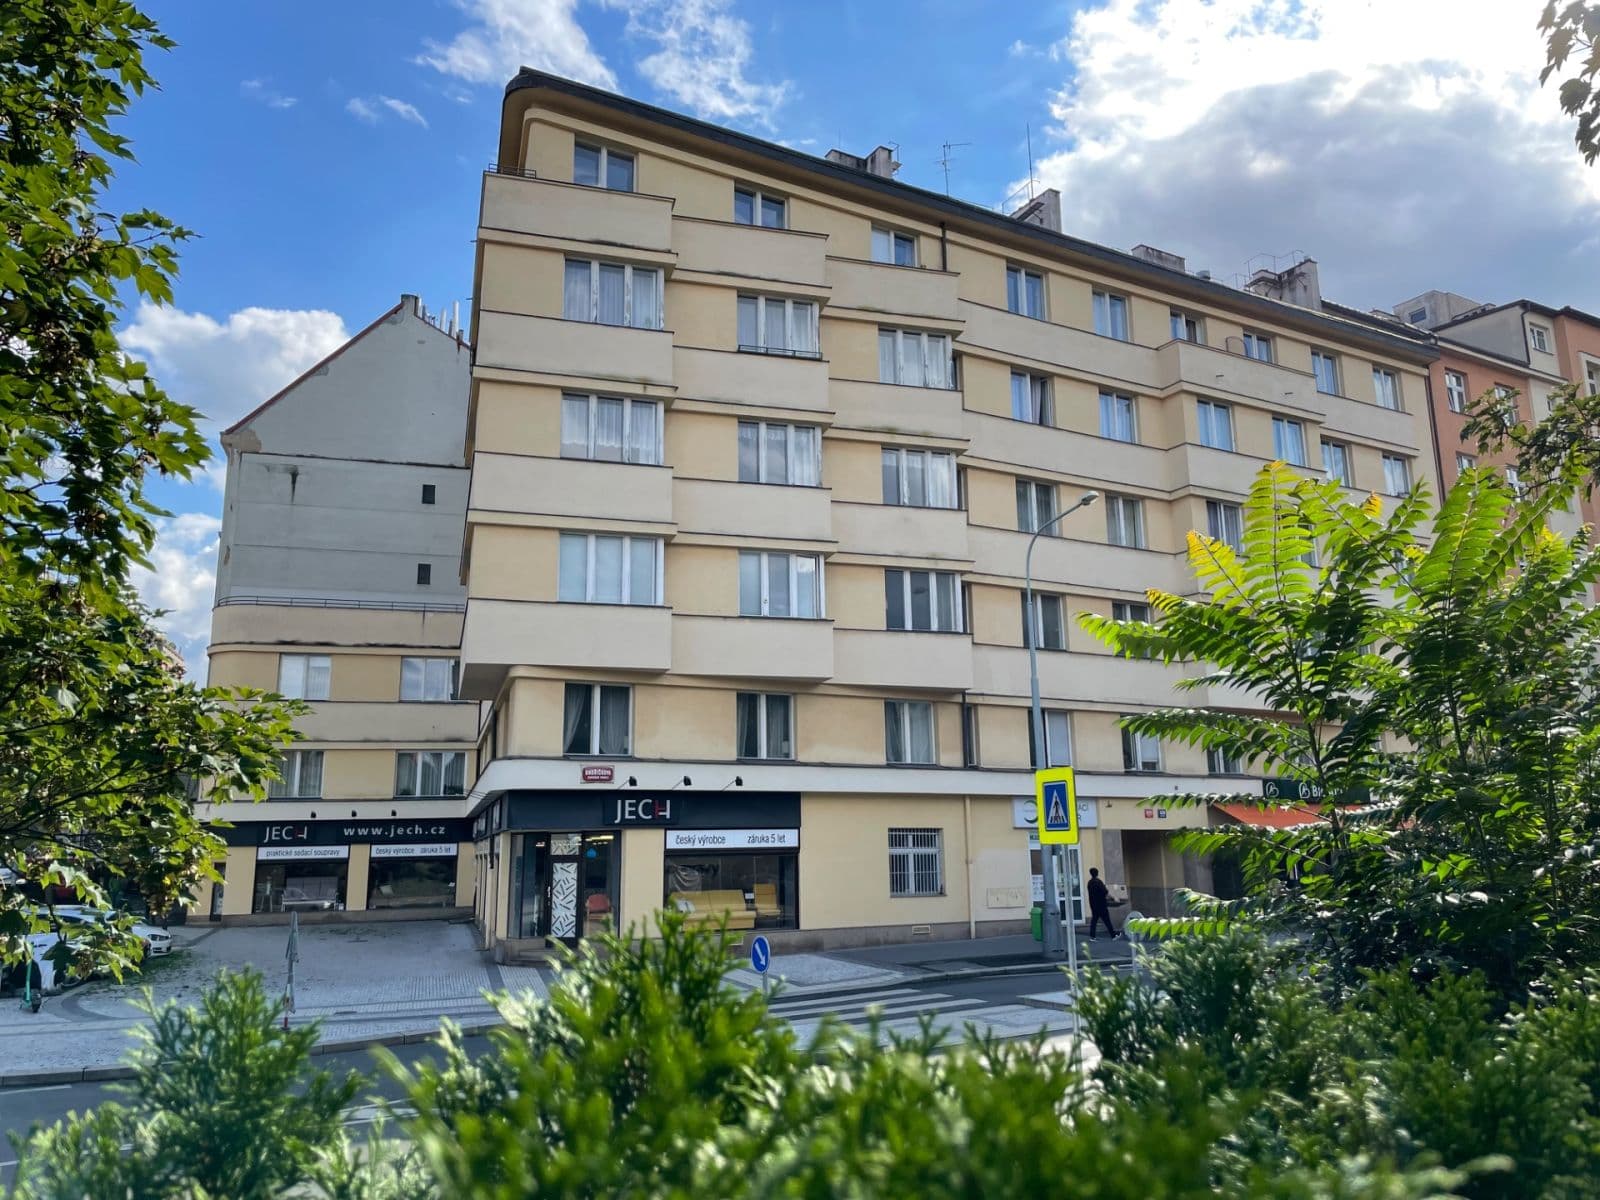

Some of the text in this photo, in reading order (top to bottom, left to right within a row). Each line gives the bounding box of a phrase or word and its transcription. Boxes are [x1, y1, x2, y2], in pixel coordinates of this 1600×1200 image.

[614, 799, 671, 824] JECH
[263, 825, 308, 844] JECH
[343, 824, 446, 838] www.jech.cz
[675, 833, 786, 847] český výrobce záruka 5 let
